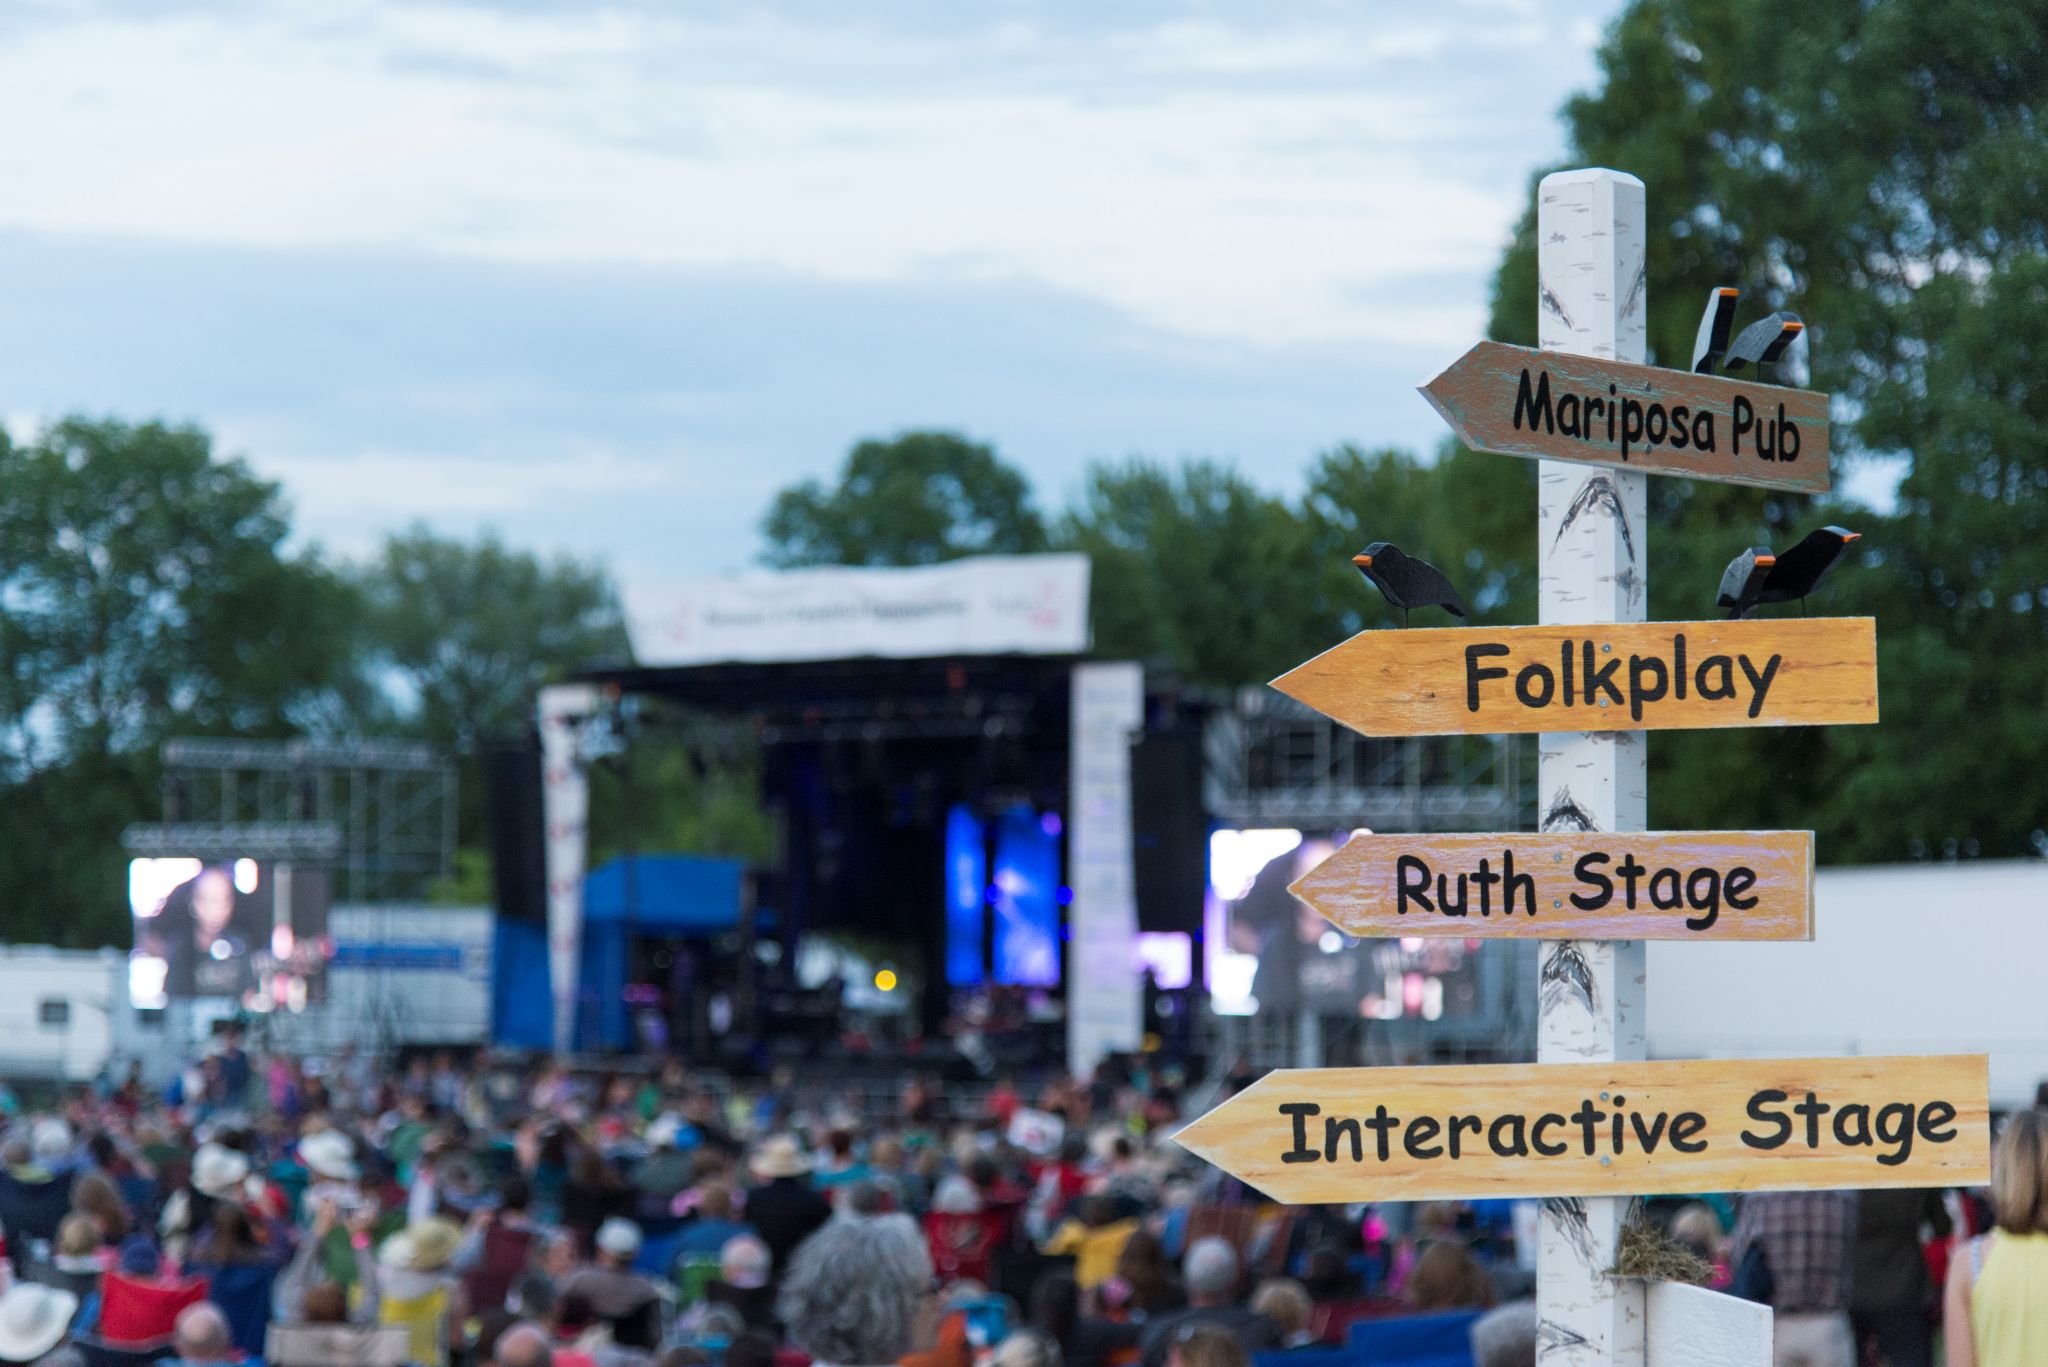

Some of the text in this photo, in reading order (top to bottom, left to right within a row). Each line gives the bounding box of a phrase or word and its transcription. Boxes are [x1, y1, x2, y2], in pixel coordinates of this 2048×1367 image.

[1512, 368, 1801, 463] Mariposa Pub
[1465, 633, 1783, 723] Folkplay
[1397, 849, 1759, 931] Ruth Stage
[1278, 1090, 1957, 1166] Interactive Stage
